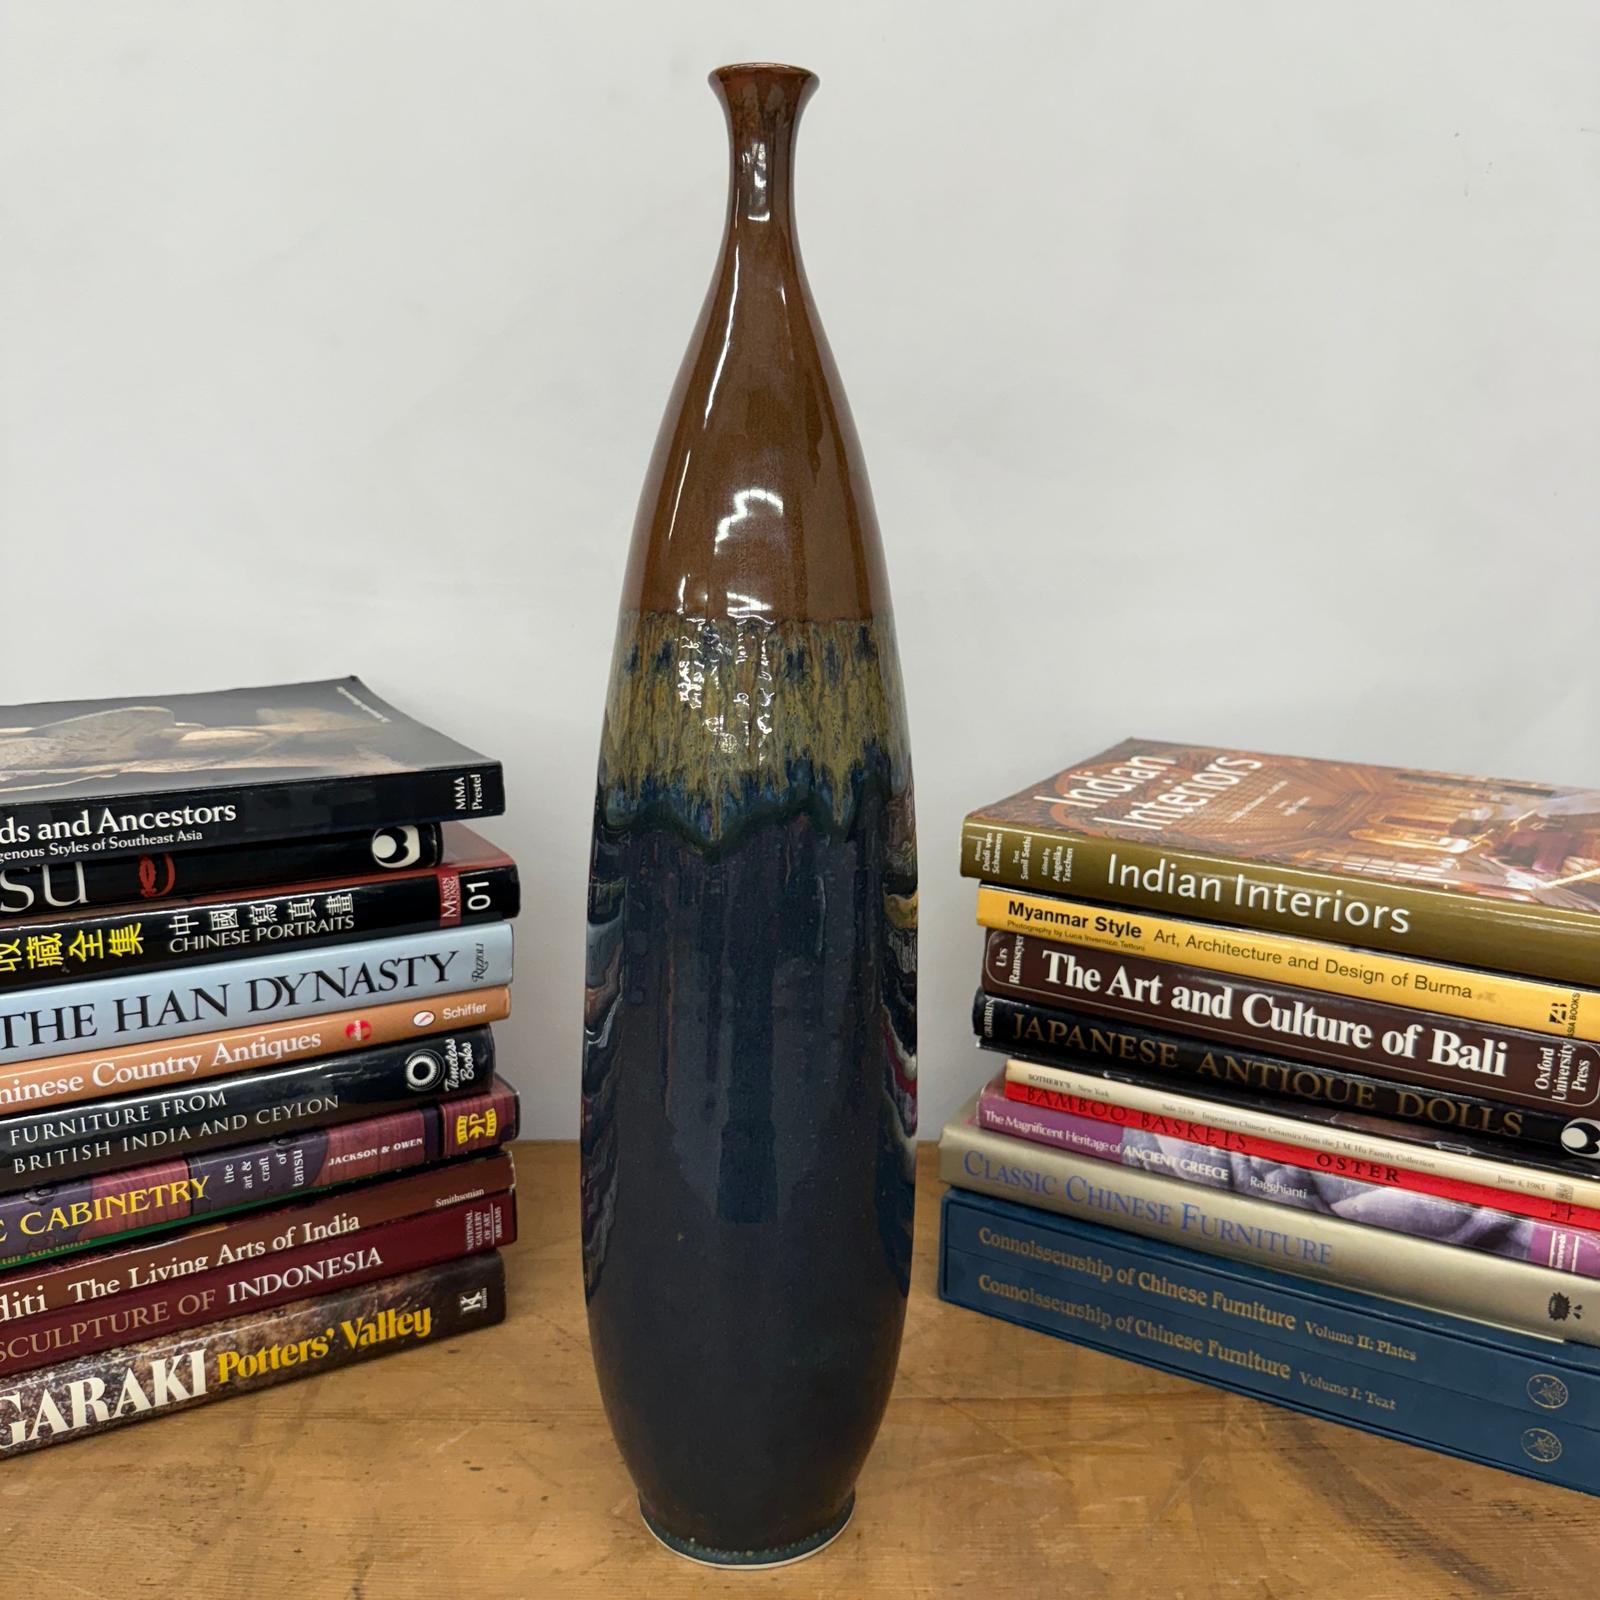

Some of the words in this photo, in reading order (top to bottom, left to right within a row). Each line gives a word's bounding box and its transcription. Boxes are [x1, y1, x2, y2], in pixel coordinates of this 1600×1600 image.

[453, 776, 467, 810] MMA
[470, 773, 483, 810] Prestel
[1034, 754, 1177, 809] Indian
[1093, 756, 1263, 830] Interiors
[37, 809, 93, 841] and
[97, 803, 237, 834] Ancestors
[49, 840, 90, 857] Styles
[92, 838, 107, 851] of
[109, 832, 174, 849] Southeast
[176, 830, 203, 842] Asia
[1021, 836, 1032, 858] Sethi
[1020, 858, 1029, 880] Sunil
[1052, 845, 1063, 882] Angelika
[1062, 847, 1073, 882] Taschen
[466, 881, 491, 911] 01
[1107, 853, 1222, 902] Indian
[1234, 873, 1410, 934] Interiors
[169, 929, 250, 953] CHINESE
[256, 914, 355, 942] PORTRAITS
[1007, 920, 1052, 936] Photography
[1053, 928, 1063, 938] by
[995, 947, 1008, 967] Urs
[1008, 900, 1089, 928] Myanmar
[1094, 916, 1142, 938] Style
[1153, 928, 1181, 948] Art,
[1185, 934, 1282, 964] Architecture
[1287, 956, 1319, 972] and
[1325, 959, 1385, 985] Design
[1391, 972, 1410, 987] of
[1414, 974, 1473, 999] Burma
[1009, 934, 1025, 985] Ramseyer
[0, 1003, 98, 1050] THE
[112, 983, 231, 1033] HAN
[245, 950, 460, 1014] DYNASTY
[443, 1002, 488, 1020] Schiffer
[1041, 949, 1101, 992] The
[1105, 964, 1163, 1006] Art
[1170, 985, 1232, 1020] and
[1241, 992, 1373, 1049] Culture
[1381, 1023, 1424, 1060] of
[1427, 1028, 1509, 1078] Bali
[1569, 992, 1582, 1021] BOOKS
[93, 1054, 202, 1088] Country
[211, 1032, 322, 1067] Antiques
[444, 1038, 459, 1092] Timeless
[460, 1041, 475, 1081] Books
[1013, 1012, 1179, 1069] JAPANESE
[1196, 1051, 1376, 1110] ANTIQUE
[1396, 1089, 1525, 1138] DOLLS
[1534, 1047, 1555, 1090] Oxford
[1552, 1041, 1576, 1101] University
[1571, 1059, 1591, 1092] Press
[1027, 1073, 1072, 1090] SOTHEBY'S
[10, 1104, 151, 1146] FURNITURE
[161, 1090, 227, 1118] FROM
[13, 1140, 111, 1174] BRITISH
[123, 1125, 191, 1152] INDIA
[199, 1114, 248, 1137] AND
[256, 1095, 339, 1125] CEYLON
[1026, 1085, 1128, 1122] BAMBOO
[1141, 1111, 1247, 1151] BASKETS
[1316, 1153, 1400, 1183] OSTER
[241, 1160, 252, 1172] &
[259, 1156, 270, 1182] craft
[276, 1153, 287, 1165] of
[293, 1149, 305, 1187] tansu
[328, 1147, 378, 1166] JACKSON
[381, 1145, 391, 1155] &
[393, 1137, 423, 1151] OWEN
[985, 1109, 1004, 1125] The
[1005, 1115, 1064, 1139] Magnificent
[1065, 1128, 1109, 1152] Heritage
[1110, 1143, 1122, 1154] of
[1122, 1145, 1180, 1169] ANCIENT
[1180, 1158, 1229, 1181] GREECE
[1250, 1175, 1307, 1199] Ragghianti
[224, 1163, 235, 1184] the
[243, 1174, 253, 1189] art
[20, 1175, 210, 1236] CABINETRY
[435, 1188, 485, 1208] Smithsonian
[963, 1150, 1056, 1198] CLASSIC
[1064, 1175, 1171, 1226] CHINESE
[1181, 1202, 1333, 1265] FURNITURE
[67, 1278, 121, 1303] The
[128, 1255, 208, 1289] Living
[216, 1240, 266, 1267] Arts
[272, 1225, 297, 1250] of
[303, 1212, 361, 1243] India
[178, 1289, 216, 1316] OF
[227, 1246, 384, 1305] INDONESIA
[978, 1226, 1113, 1283] Connoisseurship
[1116, 1267, 1136, 1285] of
[1138, 1271, 1208, 1307] Chinese
[1211, 1290, 1297, 1331] Furniture
[1305, 1320, 1354, 1345] Volume
[1356, 1334, 1374, 1351] II:
[1376, 1340, 1417, 1361] Plates
[978, 1274, 1113, 1330] Connoisseurship
[1115, 1315, 1135, 1334] of
[1135, 1319, 1204, 1354] Chinese
[1207, 1339, 1292, 1380] Furniture
[1300, 1371, 1349, 1396] Volume
[1350, 1386, 1363, 1401] I:
[1365, 1390, 1397, 1411] Text
[0, 1348, 209, 1449] GARAKI
[341, 1307, 432, 1350] Valley
